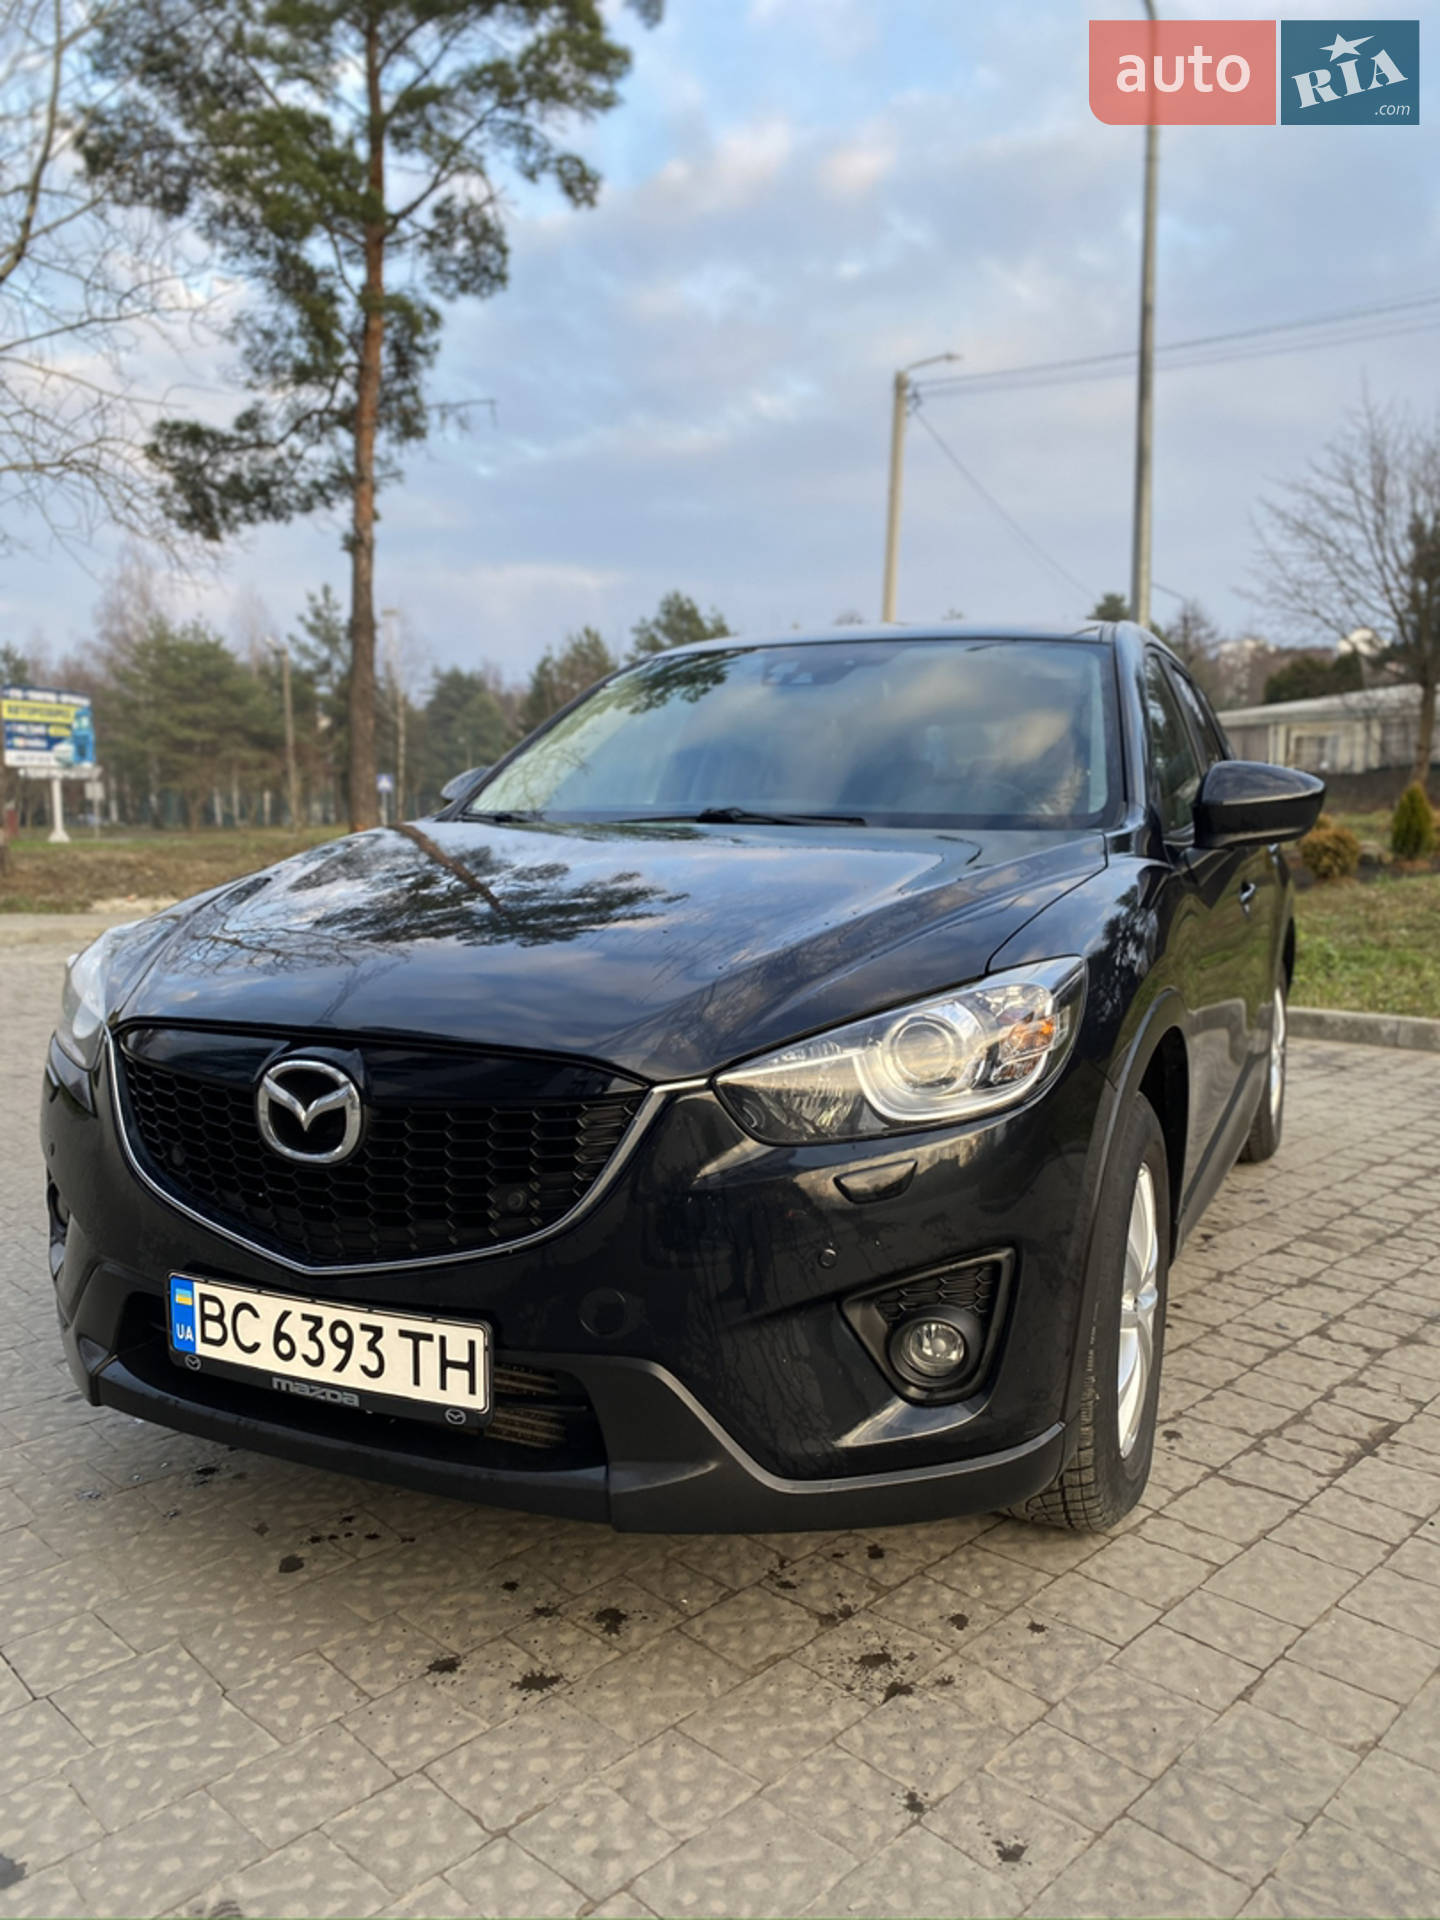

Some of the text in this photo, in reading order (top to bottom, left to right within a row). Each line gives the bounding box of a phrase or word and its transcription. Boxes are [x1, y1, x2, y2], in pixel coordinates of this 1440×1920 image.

[176, 1323, 194, 1342] UA
[199, 1292, 477, 1396] BC 6393 TH
[271, 1376, 360, 1408] mazda
